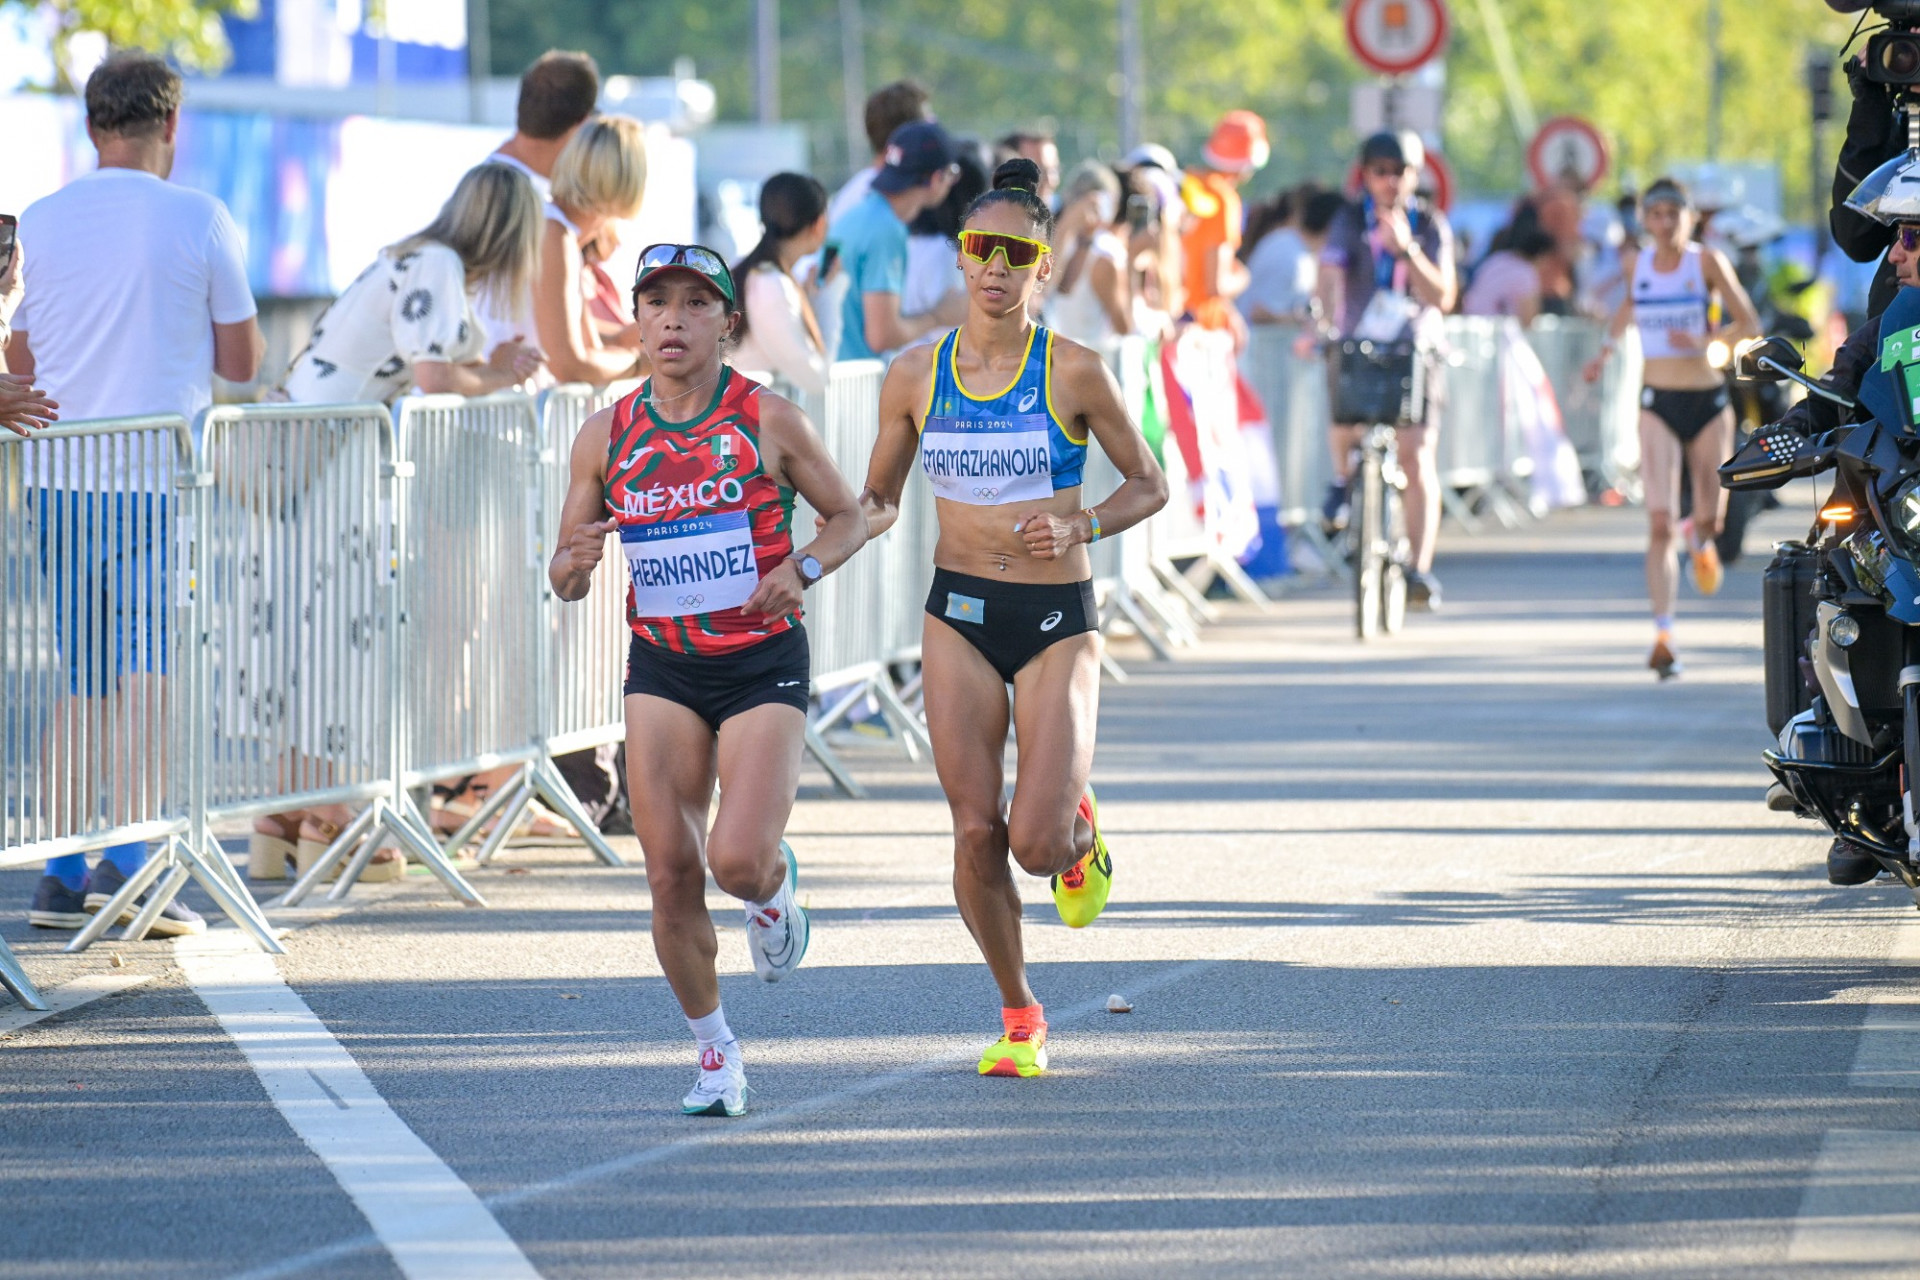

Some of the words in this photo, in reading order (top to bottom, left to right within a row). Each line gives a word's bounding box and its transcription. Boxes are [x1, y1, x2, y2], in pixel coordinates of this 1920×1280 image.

[955, 420, 984, 429] PARIS
[987, 420, 1013, 429] 2024
[923, 446, 1049, 477] MAMAZHANOVA
[623, 477, 743, 519] MÉXICO
[646, 525, 679, 537] PARIS
[682, 521, 713, 533] 2024
[630, 543, 755, 587] HERNANDEZ
